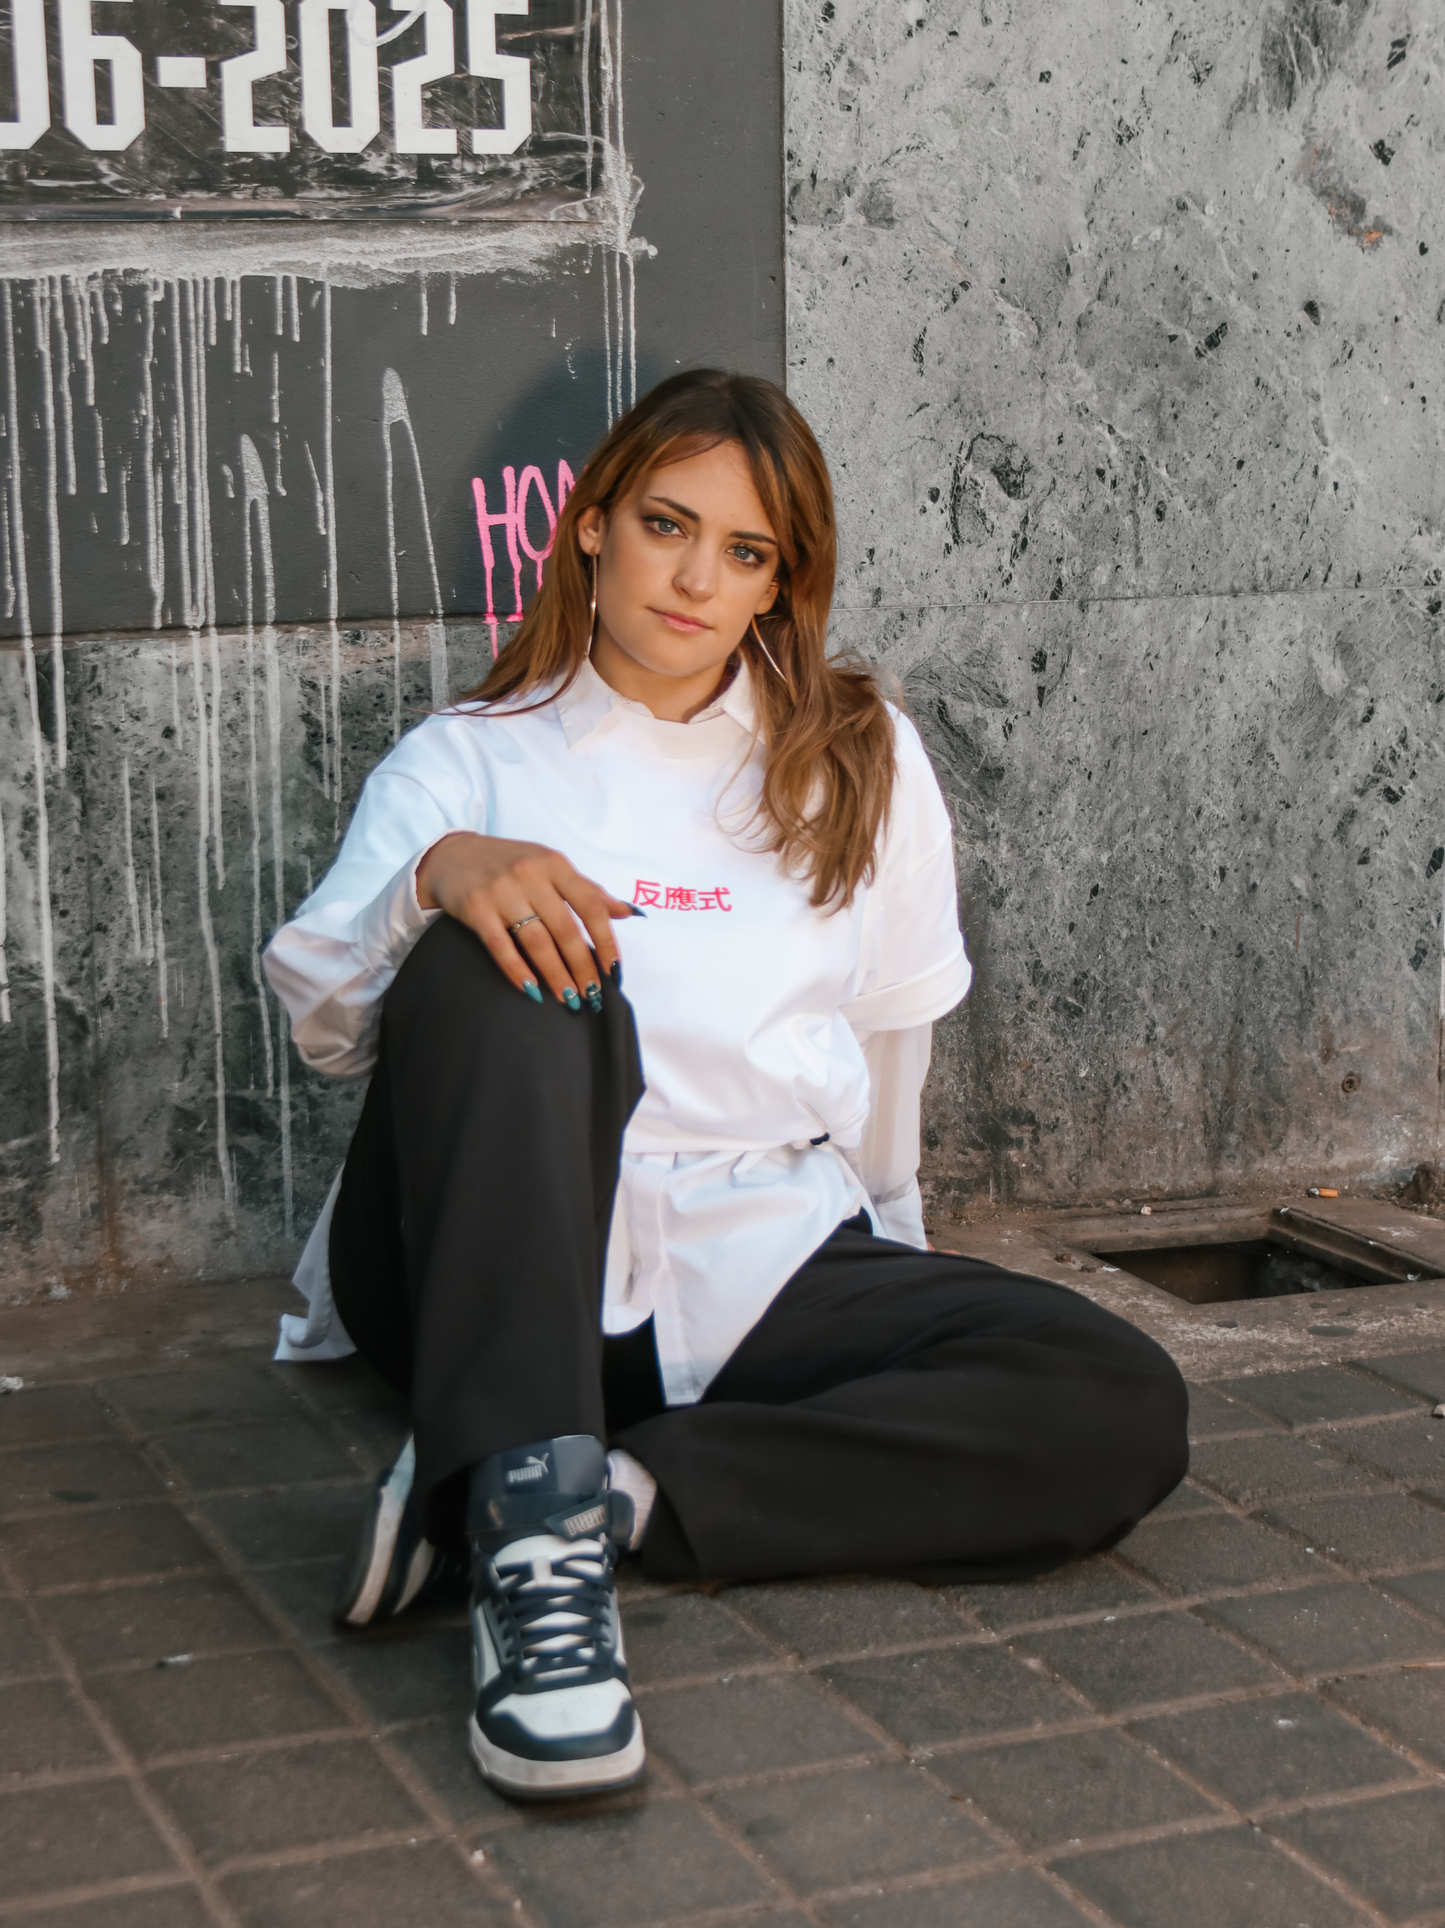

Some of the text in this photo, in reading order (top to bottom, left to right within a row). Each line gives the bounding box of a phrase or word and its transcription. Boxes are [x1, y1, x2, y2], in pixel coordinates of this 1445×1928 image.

[632, 879, 733, 912] 反應式
[507, 1464, 543, 1484] PUMA
